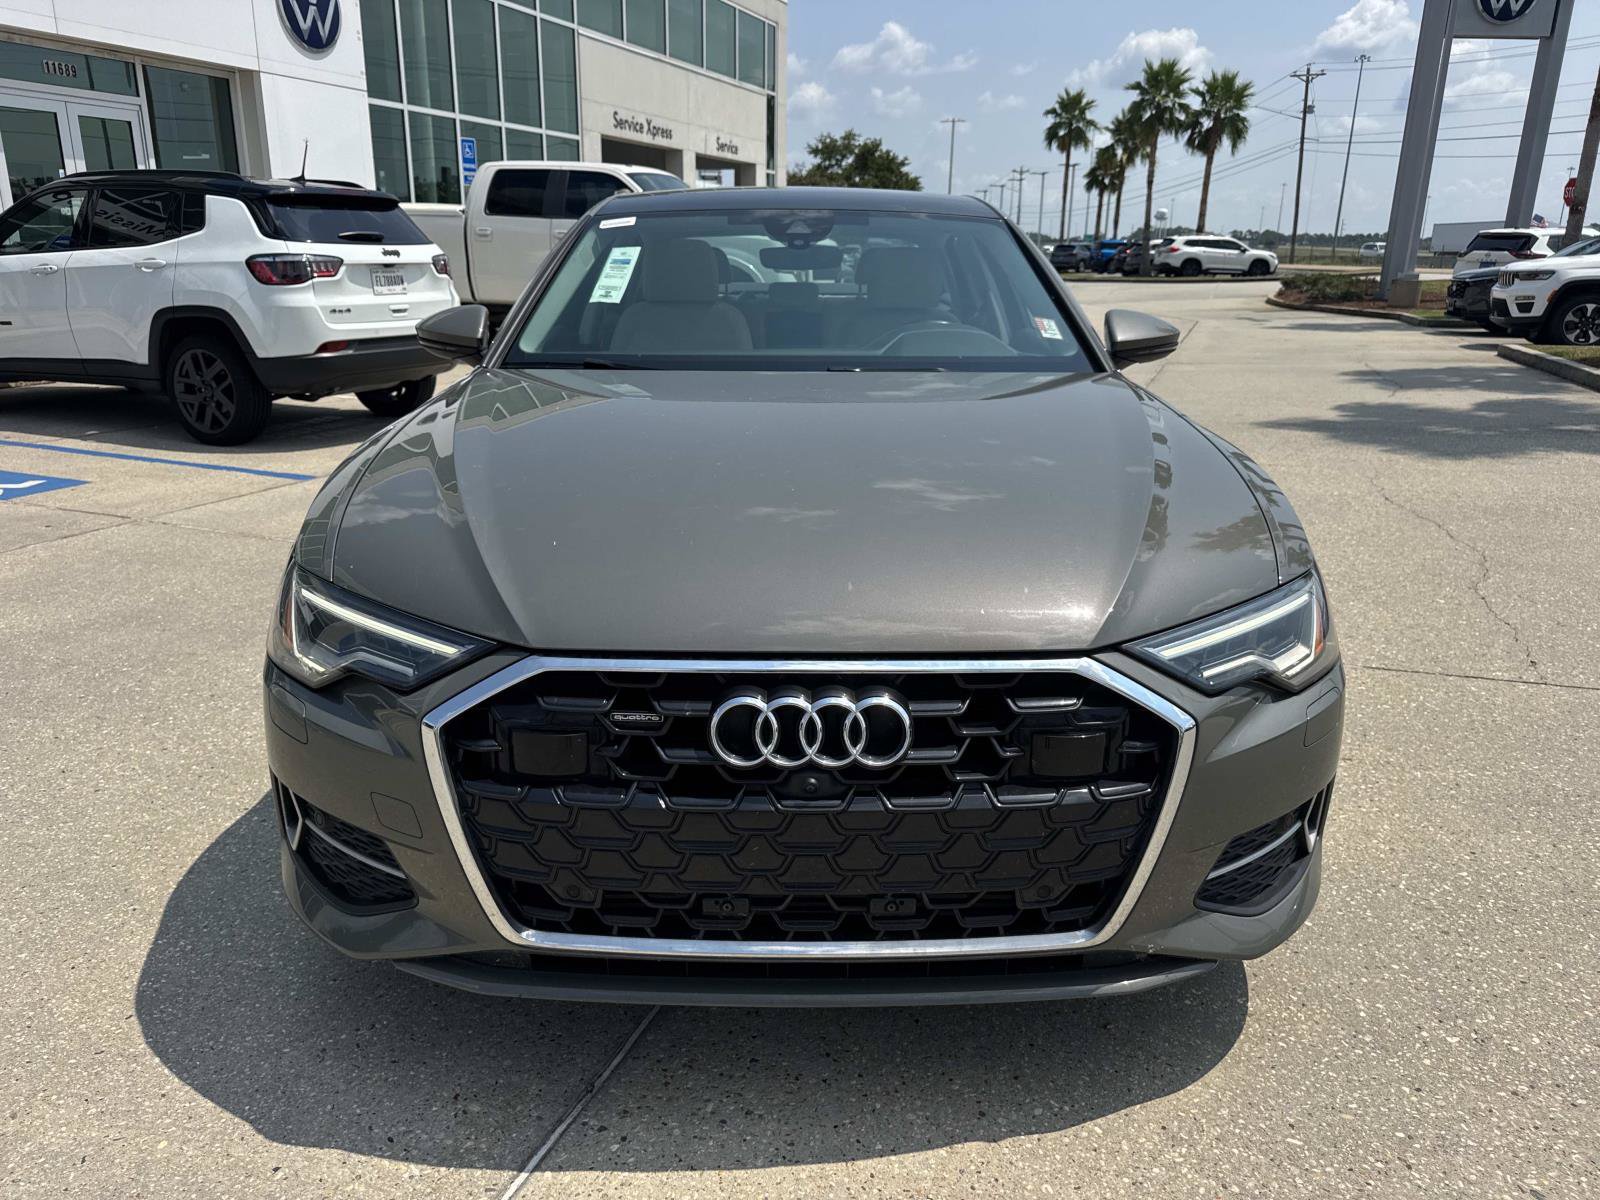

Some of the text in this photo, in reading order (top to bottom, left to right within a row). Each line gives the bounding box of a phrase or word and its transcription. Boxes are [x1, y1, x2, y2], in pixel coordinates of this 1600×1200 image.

[44, 61, 77, 77] 11689
[613, 110, 673, 140] Service Xpress
[716, 136, 738, 155] Service
[1565, 187, 1576, 199] ST
